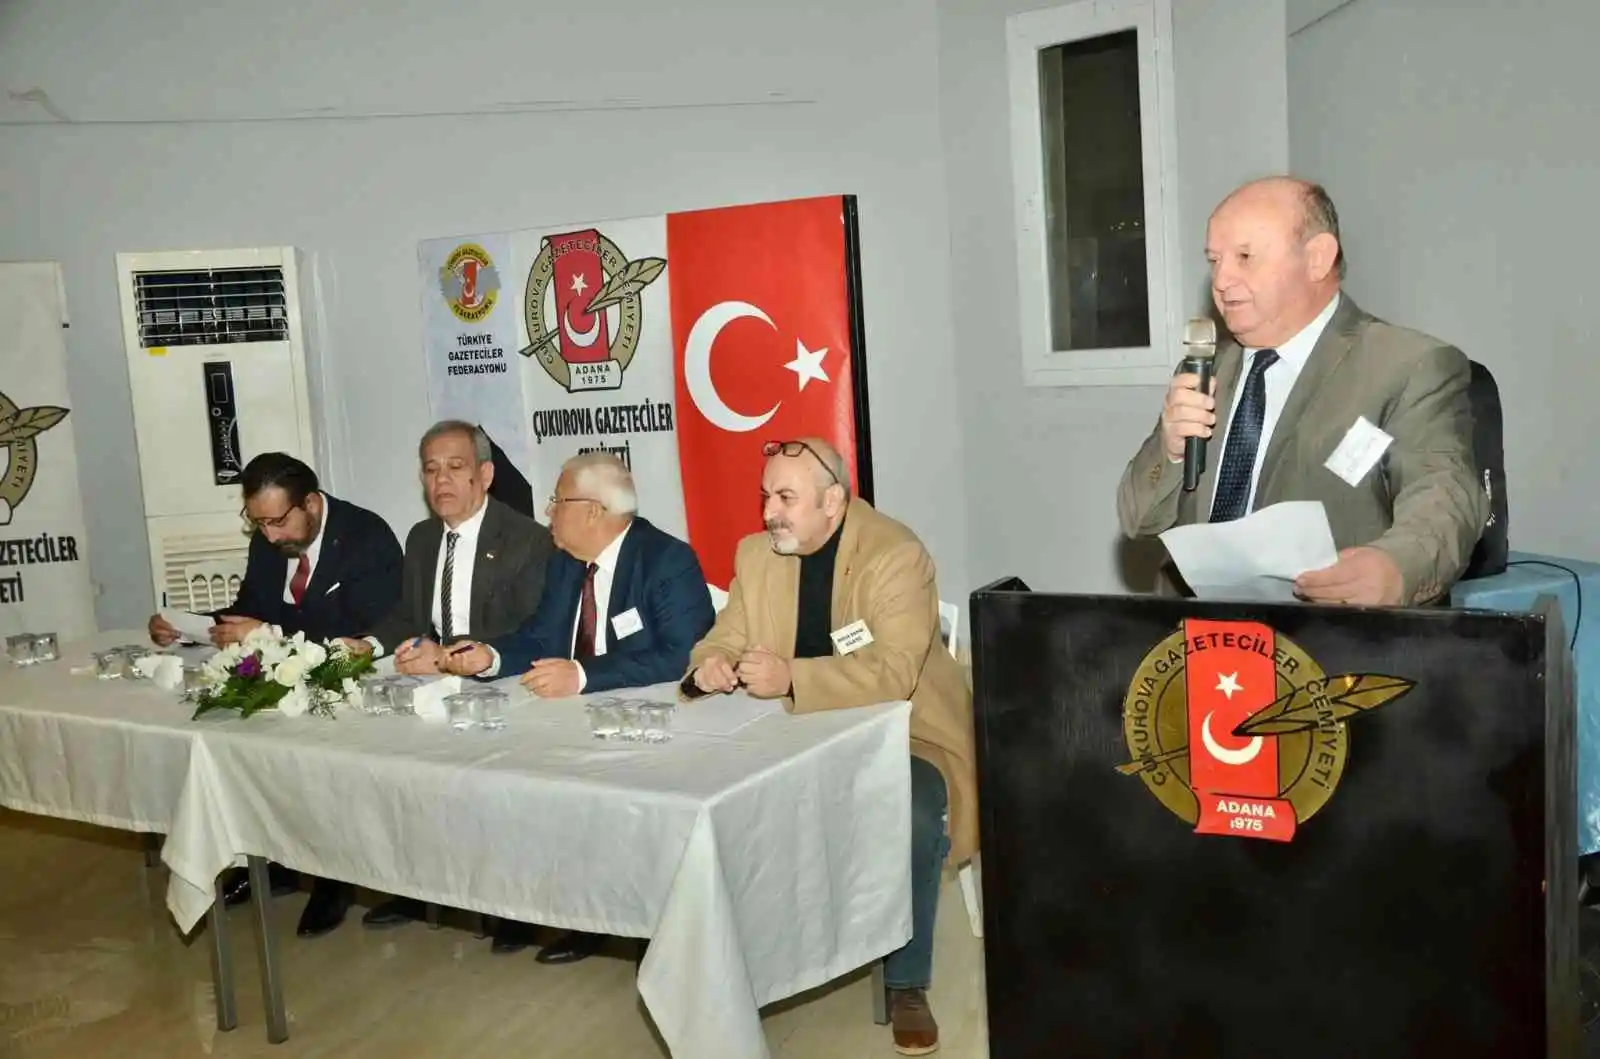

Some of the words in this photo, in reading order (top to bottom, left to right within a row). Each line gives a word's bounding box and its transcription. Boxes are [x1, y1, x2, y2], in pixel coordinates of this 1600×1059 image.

[448, 347, 503, 361] GAZETECİLER
[447, 362, 507, 376] FEDERASYONU
[575, 364, 610, 375] ADANA
[582, 374, 606, 385] 1975
[533, 407, 594, 444] ÇUKUROVA
[595, 397, 673, 434] GAZETECİLER
[1154, 632, 1300, 674] GAZETECİLER
[1306, 680, 1342, 790] CEMİYETİ
[1215, 799, 1277, 820] ADANA
[1230, 817, 1264, 832] 1975
